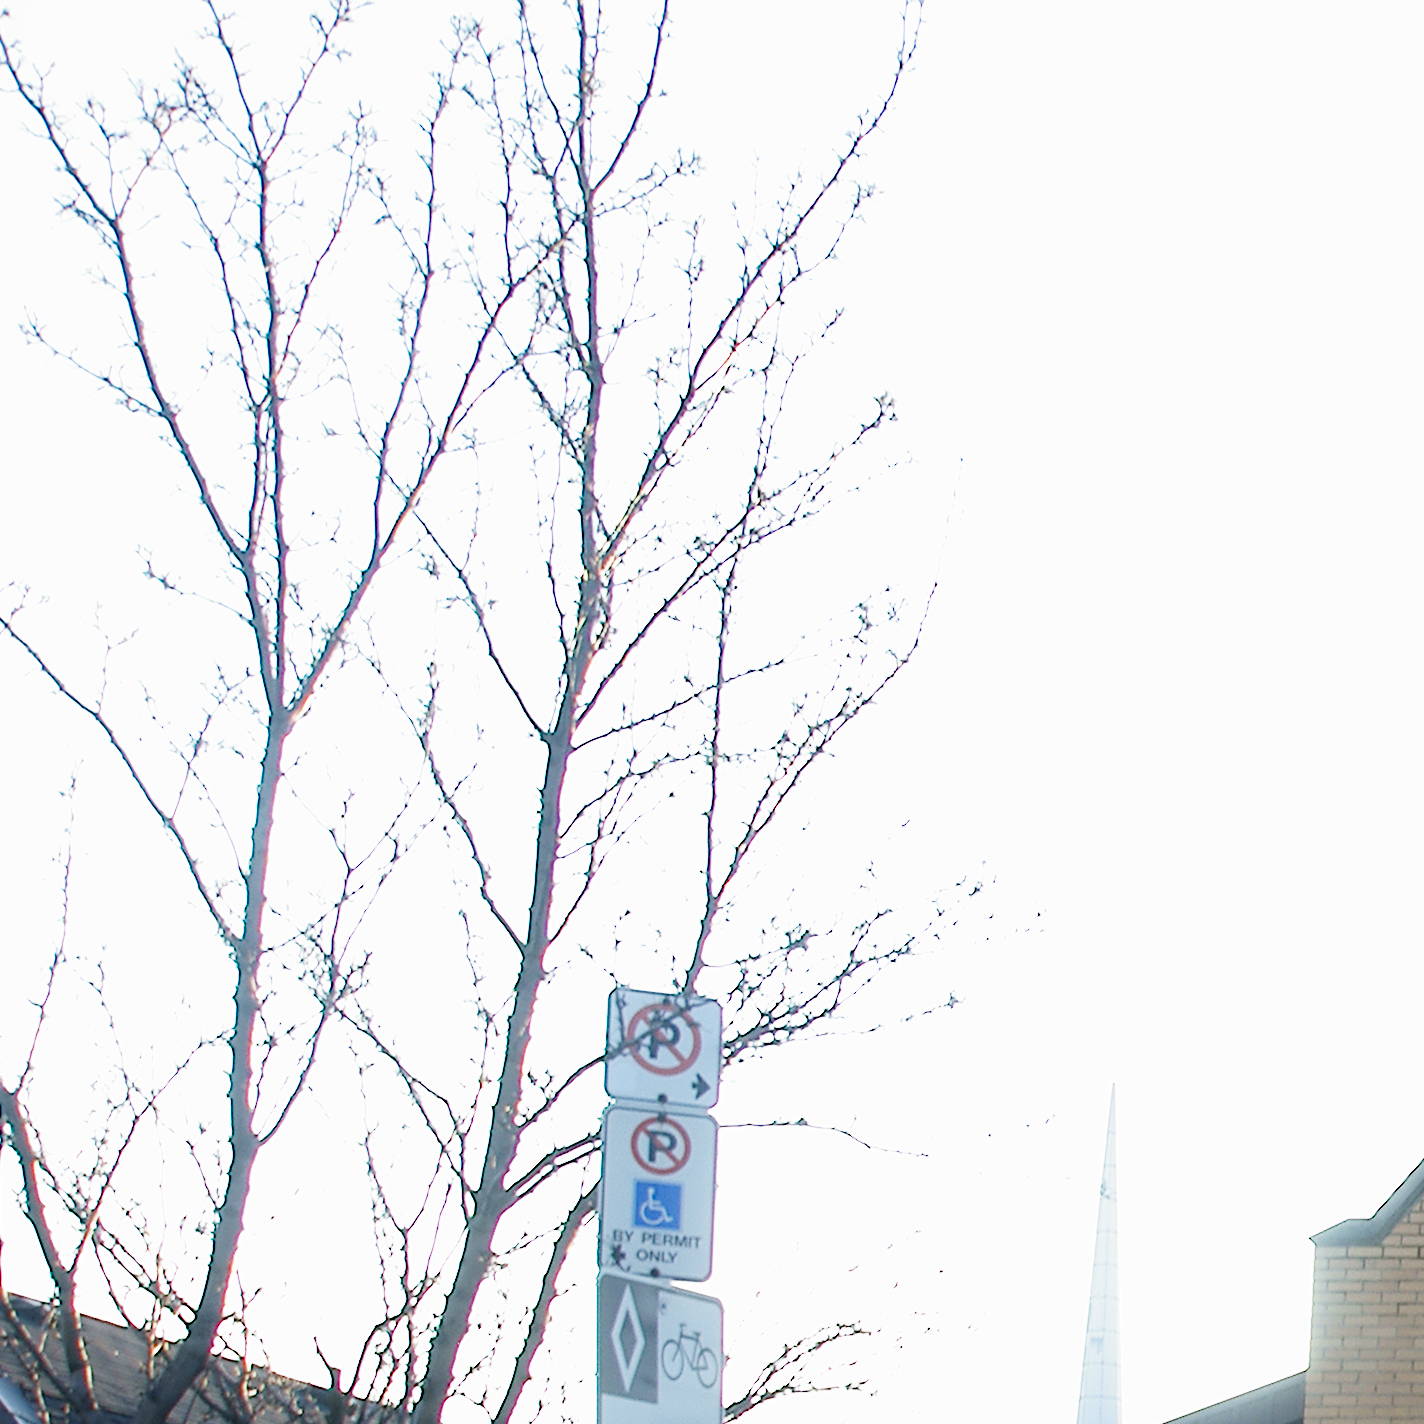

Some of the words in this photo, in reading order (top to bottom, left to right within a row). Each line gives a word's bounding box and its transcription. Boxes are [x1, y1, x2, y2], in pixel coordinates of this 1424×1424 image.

[646, 1130, 678, 1163] P
[613, 1229, 634, 1242] BY
[641, 1231, 702, 1249] PERMIT
[636, 1248, 678, 1264] ONLY
